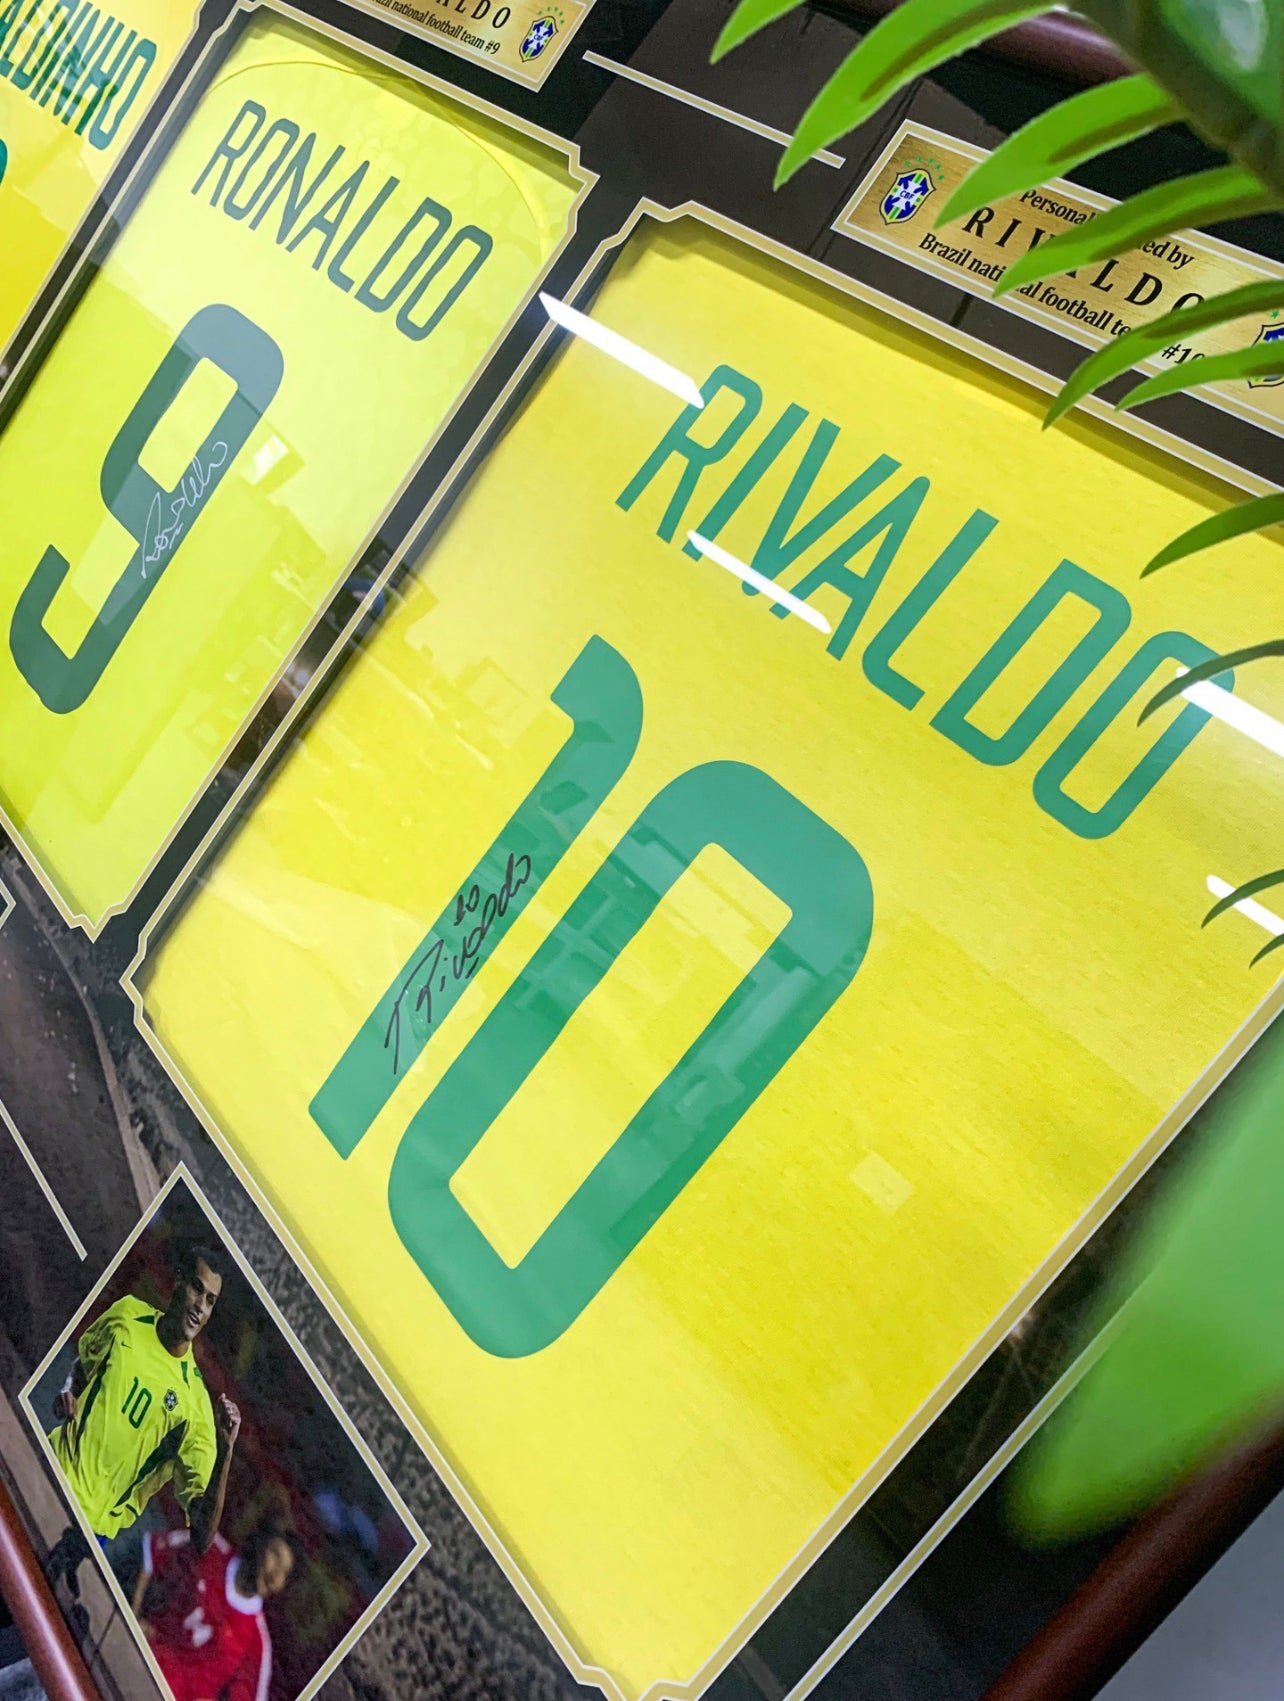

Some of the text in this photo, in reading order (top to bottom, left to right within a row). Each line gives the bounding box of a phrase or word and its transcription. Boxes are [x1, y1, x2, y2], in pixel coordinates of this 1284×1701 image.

[391, 3, 428, 26] national
[425, 12, 462, 39] football
[460, 29, 486, 50] team
[485, 39, 501, 55] #9
[435, 0, 511, 29] LDO
[190, 99, 494, 342] RONALDO
[1165, 242, 1195, 270] by
[919, 232, 973, 267] Brazil
[966, 256, 1044, 299] natial
[1037, 285, 1115, 330] football
[9, 303, 285, 715] 9
[615, 364, 1236, 840] RIVALDO
[308, 634, 875, 1359] 10
[121, 1376, 152, 1429] 10
